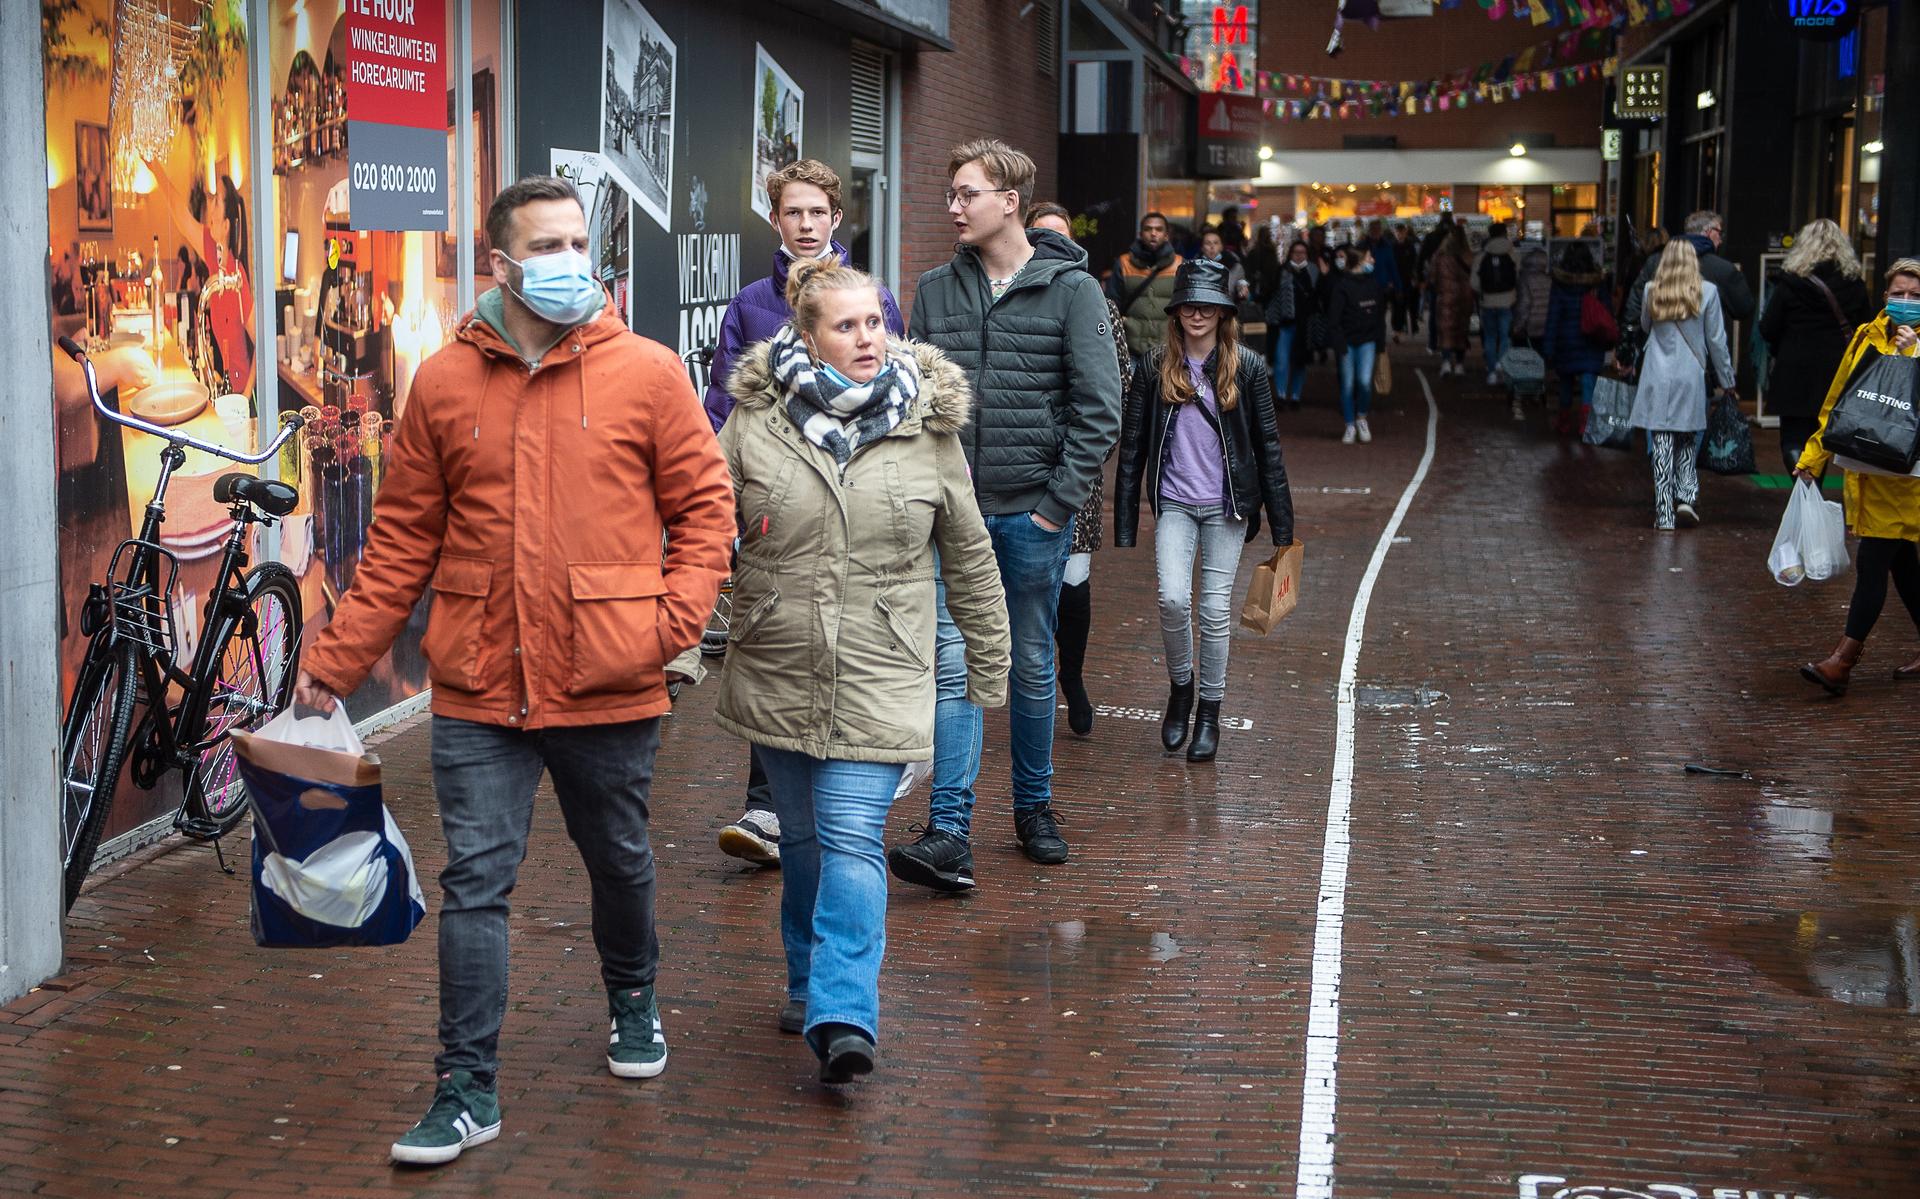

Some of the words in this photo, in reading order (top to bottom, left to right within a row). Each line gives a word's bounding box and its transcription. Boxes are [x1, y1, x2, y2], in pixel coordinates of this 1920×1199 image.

[351, 27, 422, 61] WINKELRUIMTE
[424, 42, 437, 63] EN
[352, 61, 426, 93] HORECARUIMTE
[354, 162, 378, 190] 020
[381, 164, 404, 192] 800
[407, 166, 436, 194] 2000
[677, 233, 729, 304] WELKOM
[1857, 390, 1878, 401] THE
[1878, 394, 1911, 411] STING
